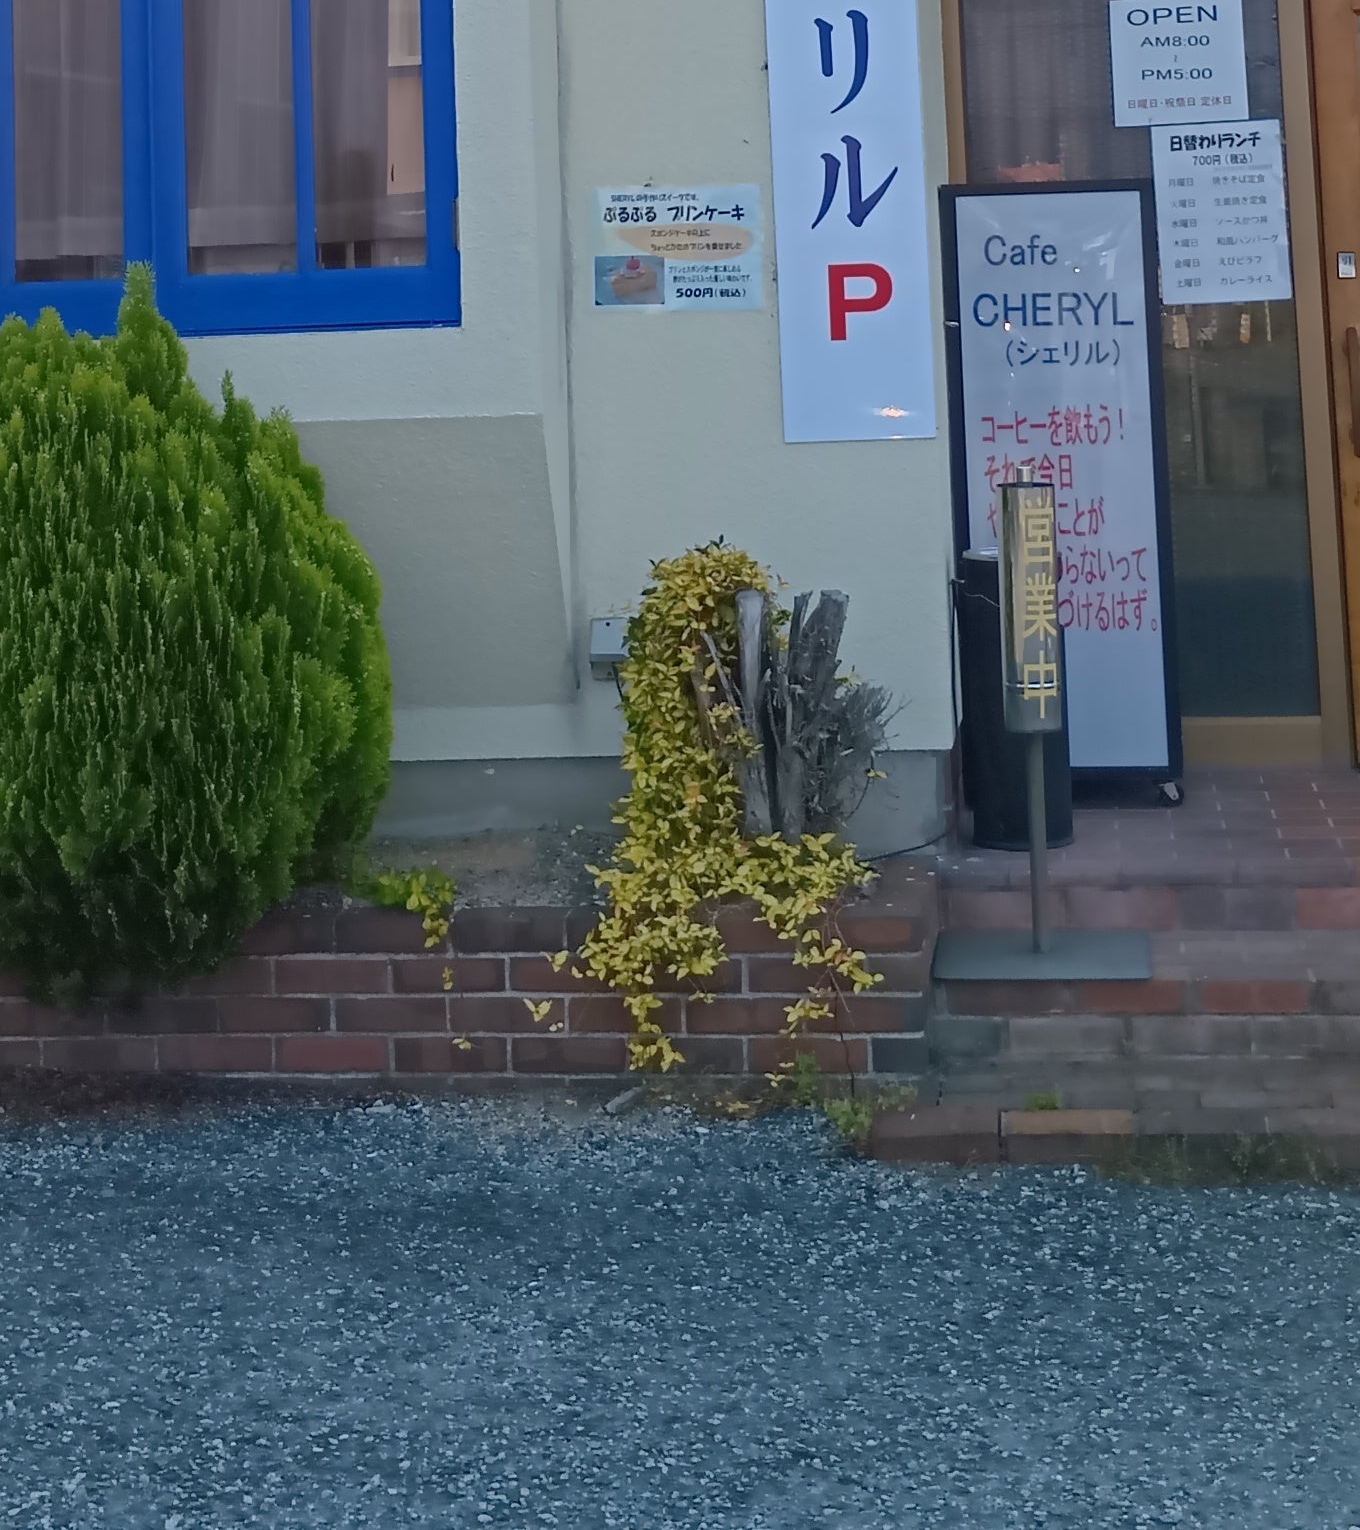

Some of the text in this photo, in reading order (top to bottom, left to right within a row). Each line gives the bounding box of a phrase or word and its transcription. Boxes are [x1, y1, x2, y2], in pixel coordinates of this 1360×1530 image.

[1127, 5, 1218, 26] OPEN
[1140, 35, 1210, 48] AM8:00
[1141, 68, 1213, 81] PM5:00
[1201, 95, 1232, 107] 定休日
[1170, 132, 1262, 152] 日替わりランチ
[1168, 177, 1194, 187] 月曜日
[1171, 198, 1196, 208] 火曜日
[604, 204, 745, 222] ぷるぷる プリンケーキ
[1171, 218, 1197, 228] 水曜日
[1174, 238, 1198, 247] 木曜日
[983, 234, 1059, 268] Cafe
[1174, 258, 1200, 268] 金曜日
[1177, 275, 1273, 288] 土曜日 カレーライス
[826, 263, 893, 342] P
[972, 290, 1135, 329] CHERYL
[1004, 337, 1122, 370] （シェリル）
[1023, 488, 1058, 719] 営業中
